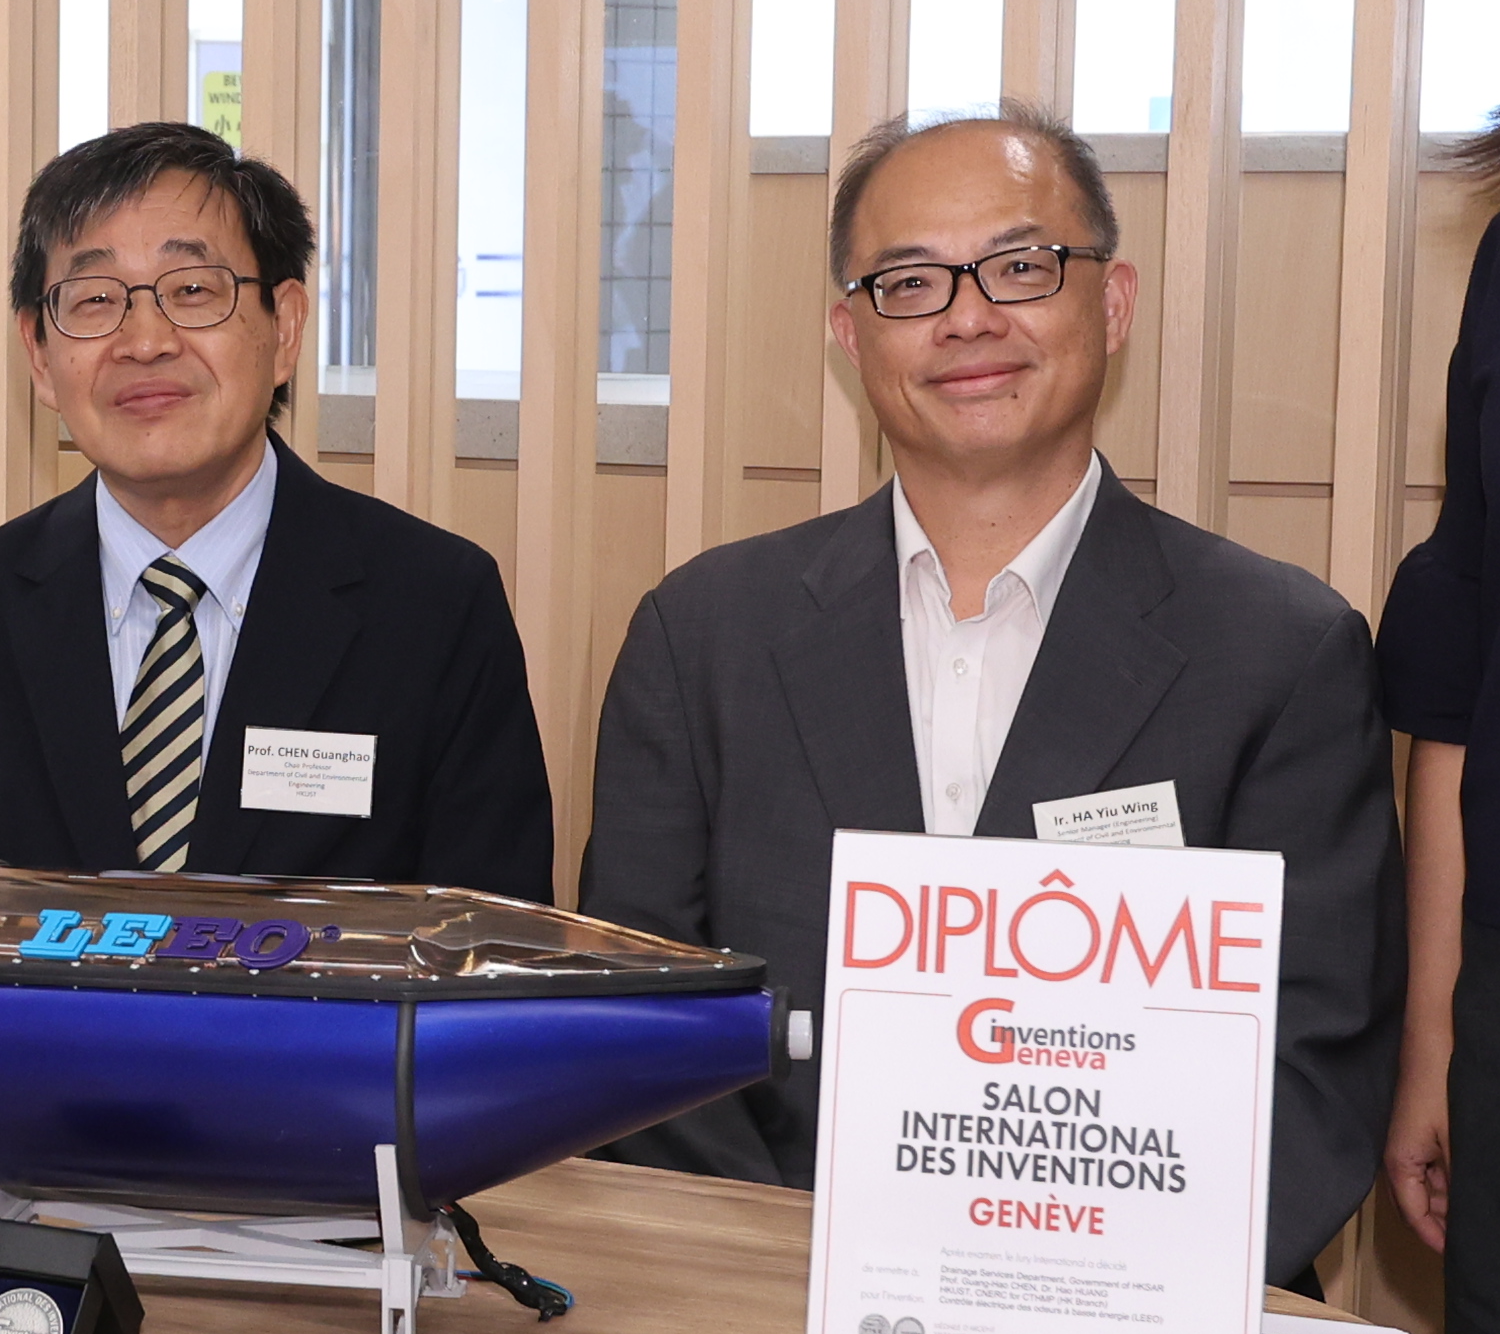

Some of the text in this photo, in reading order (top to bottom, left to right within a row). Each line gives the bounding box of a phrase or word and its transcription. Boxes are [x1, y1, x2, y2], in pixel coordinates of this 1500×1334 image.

[215, 115, 241, 136] 小
[248, 745, 370, 762] Prof. CHEN Guanghao
[1072, 811, 1092, 823] HA
[1096, 807, 1118, 819] Yiu
[1122, 801, 1158, 815] Wing
[843, 868, 1264, 993] DIPLÔME
[957, 997, 1106, 1070] Geneva
[991, 1019, 1136, 1052] inventions
[983, 1082, 1101, 1118] SALON
[902, 1110, 1181, 1158] INTERNATIONAL
[896, 1144, 1187, 1193] DES INVENTIONS
[969, 1194, 1105, 1235] GENÈVE
